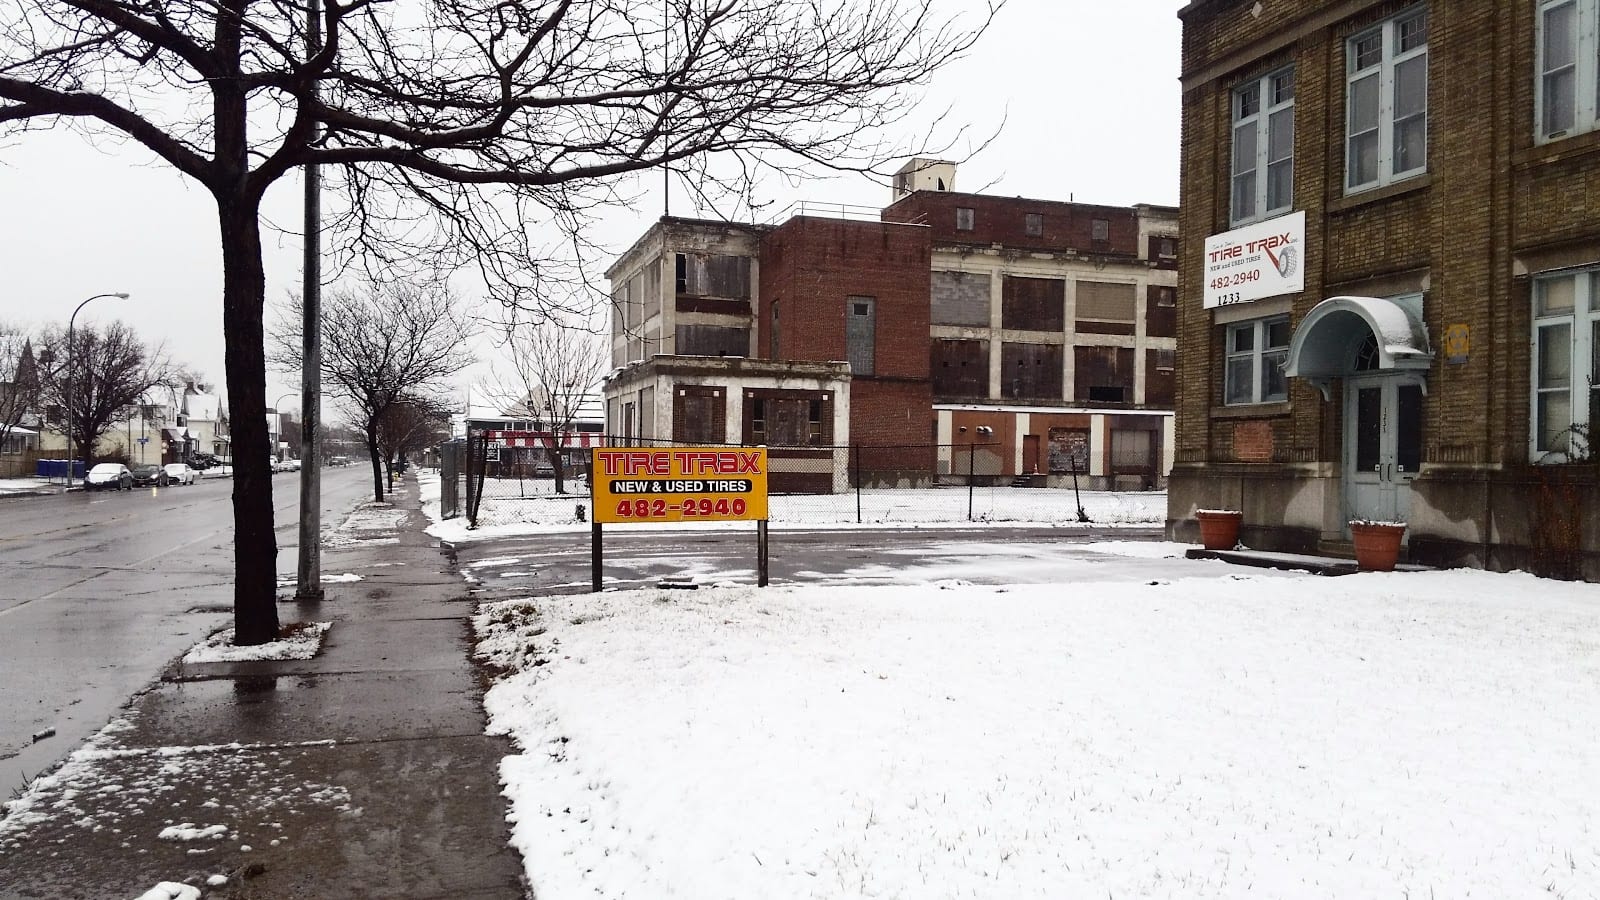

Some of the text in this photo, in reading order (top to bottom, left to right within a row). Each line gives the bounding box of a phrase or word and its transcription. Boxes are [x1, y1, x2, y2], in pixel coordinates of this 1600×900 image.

[1210, 264, 1221, 272] NEW
[1231, 258, 1245, 267] USED
[1246, 254, 1261, 263] TIRES
[1210, 269, 1260, 290] 482-2940
[1217, 292, 1240, 305] 1233
[615, 480, 747, 493] NEW & USED TIRES
[616, 498, 747, 518] 482-2940
